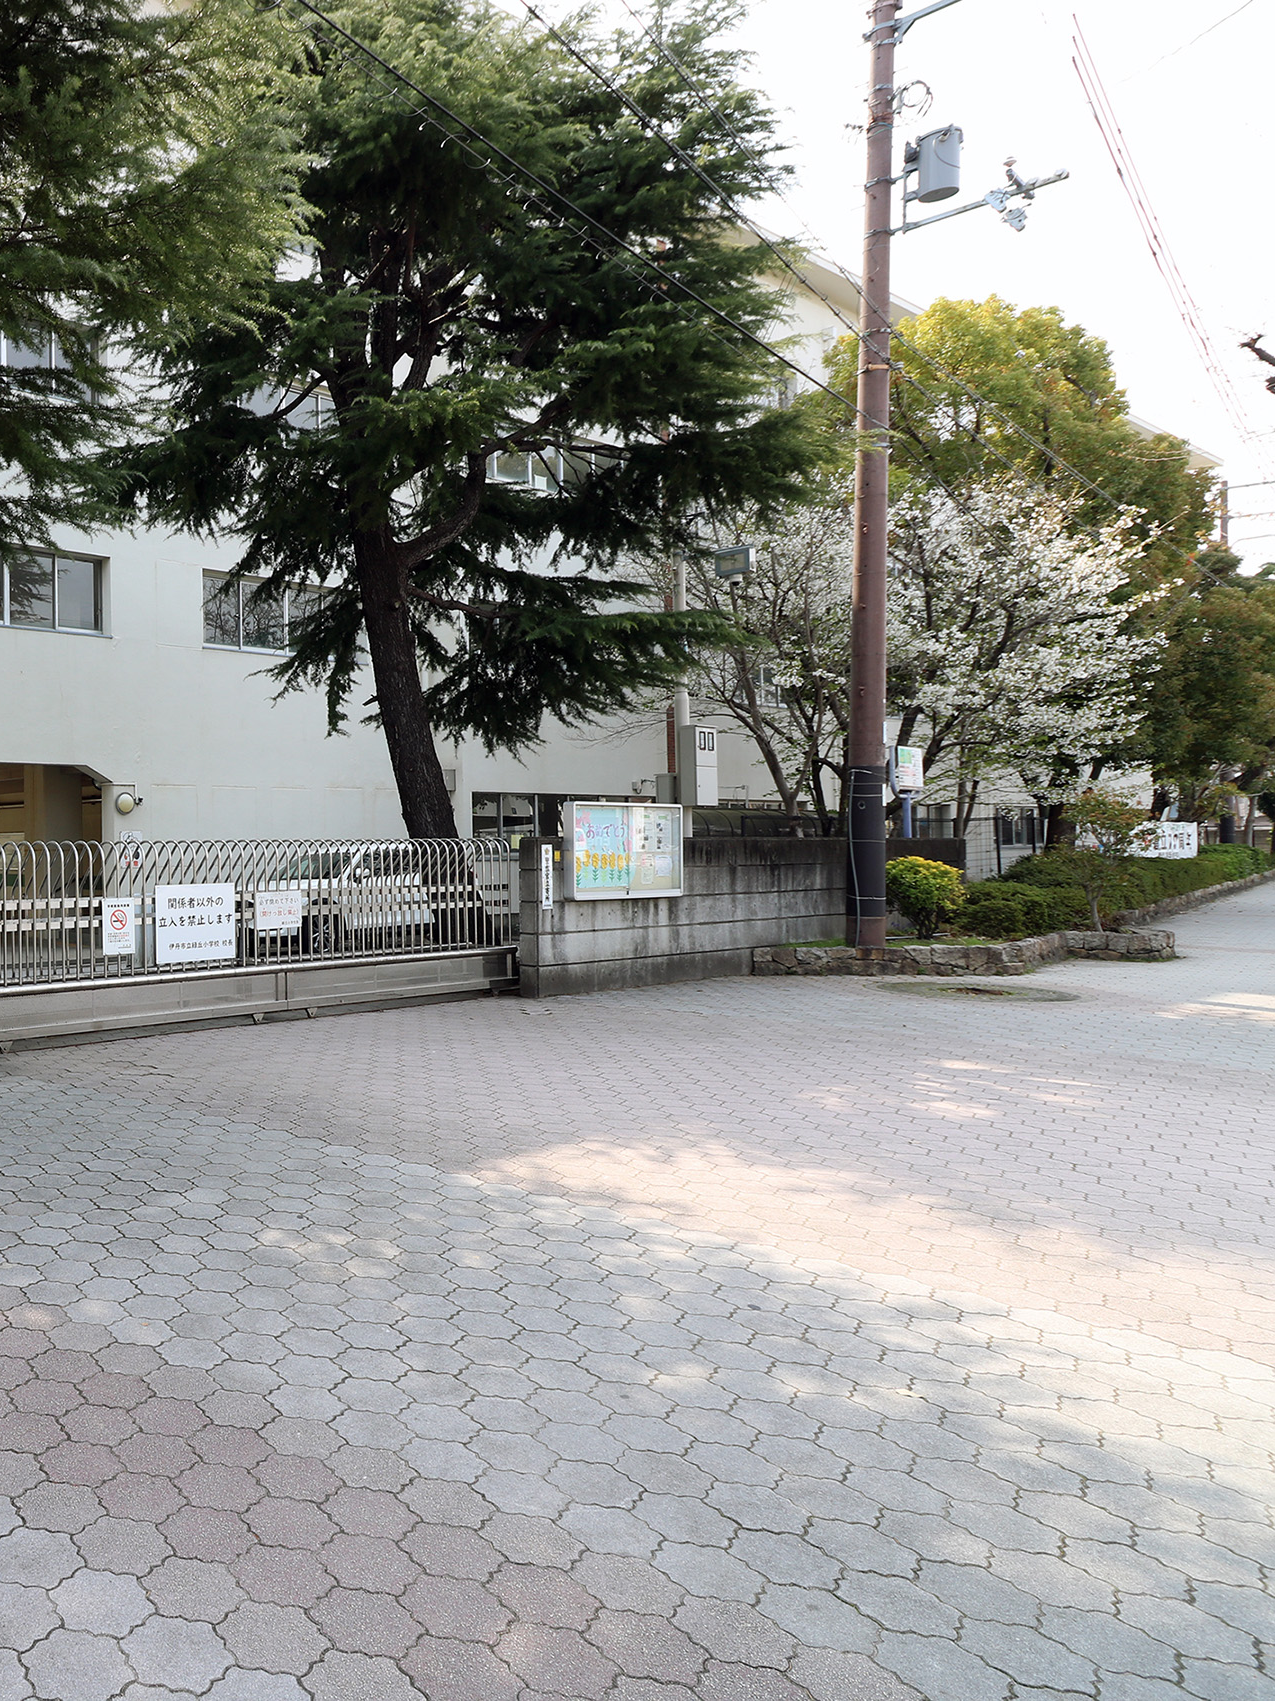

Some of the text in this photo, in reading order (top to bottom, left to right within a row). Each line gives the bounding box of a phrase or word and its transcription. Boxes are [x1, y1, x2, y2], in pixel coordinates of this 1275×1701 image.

[585, 824, 626, 839] おめでとう
[167, 896, 224, 910] 関係者以外の
[158, 913, 233, 928] 立入を禁止します
[168, 939, 233, 950] 伊丹市立緑丘小学校 校長
